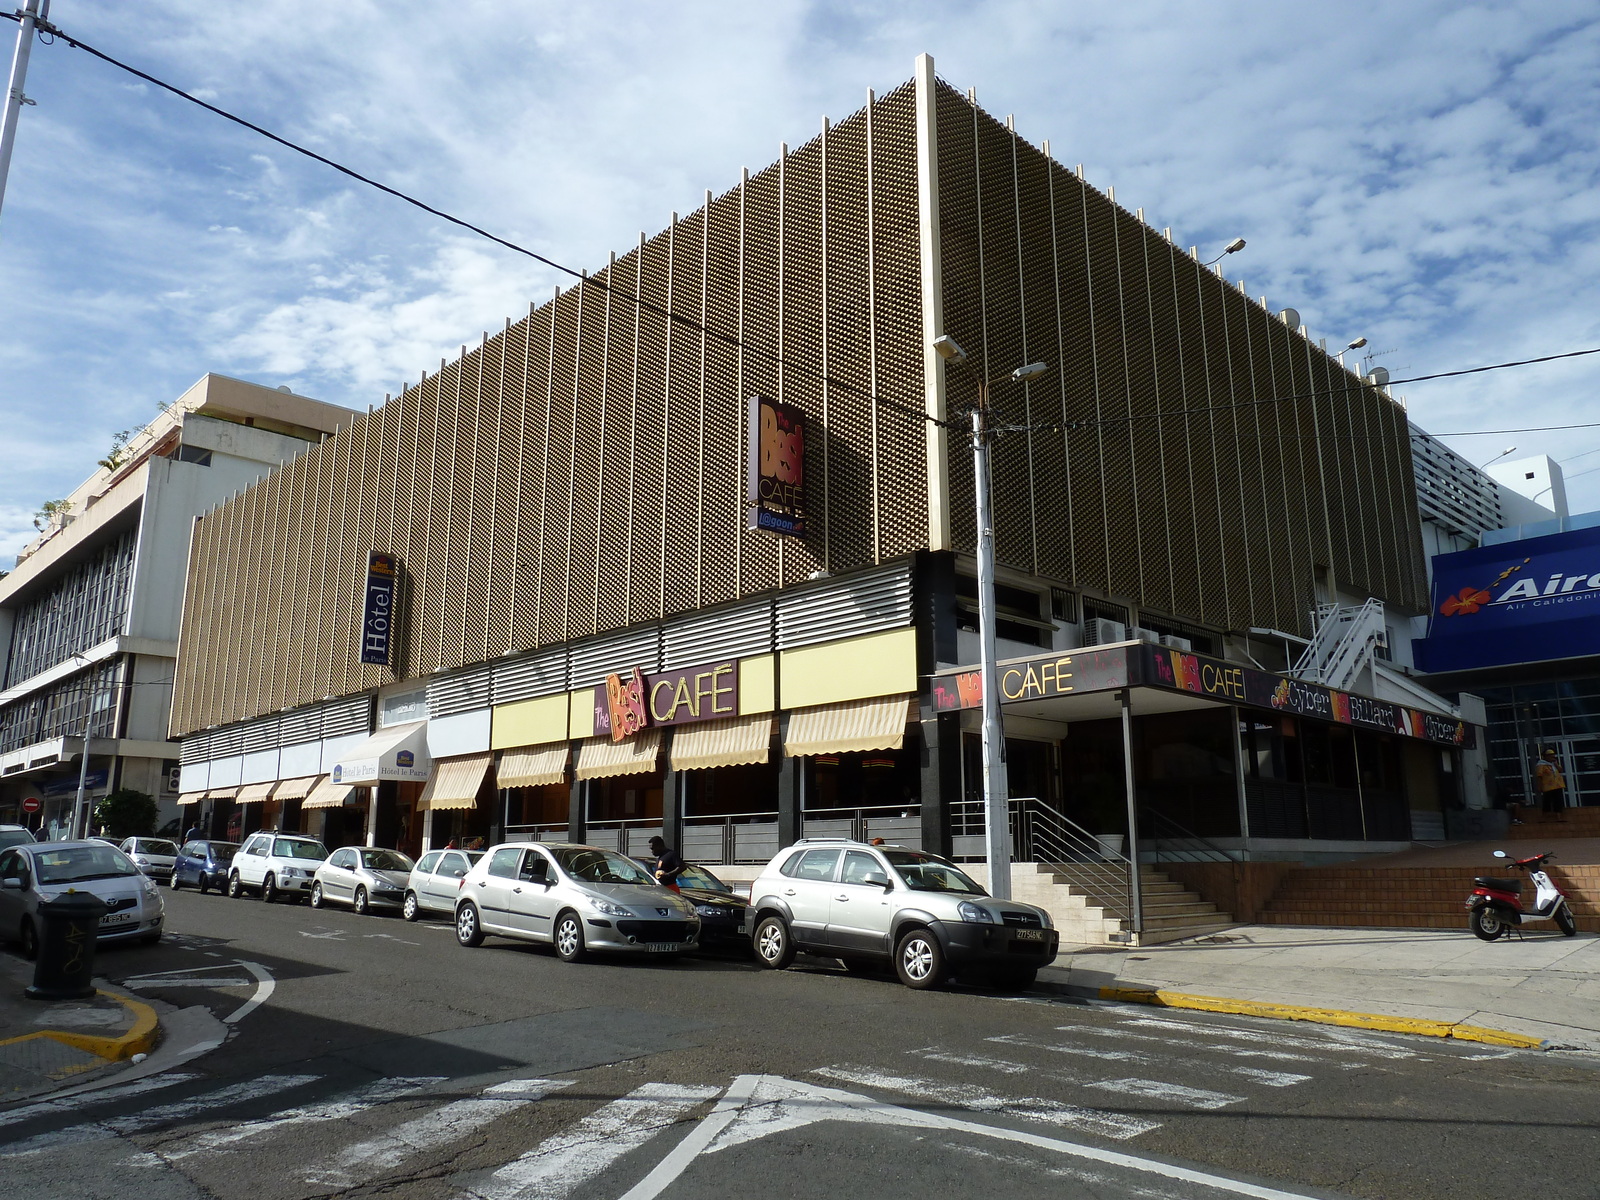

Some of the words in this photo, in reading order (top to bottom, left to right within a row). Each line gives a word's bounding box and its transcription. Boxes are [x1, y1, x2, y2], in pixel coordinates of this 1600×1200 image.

[776, 411, 790, 429] The
[758, 478, 803, 508] CAFÉ
[370, 565, 394, 575] Western
[375, 560, 389, 569] Best
[1506, 603, 1526, 611] Air
[1533, 593, 1600, 608] Calédoni
[366, 585, 390, 654] Hôtel
[370, 655, 387, 664] Paris
[934, 684, 956, 709] The
[1002, 657, 1074, 700] CAFÉ
[1154, 653, 1173, 682] The
[1202, 664, 1244, 699] CAFÉ
[594, 702, 610, 729] The
[650, 662, 733, 722] CAFÉ
[1288, 681, 1330, 714] Cyber
[1350, 696, 1395, 728] Billard
[1425, 714, 1455, 741] Cyber
[381, 767, 400, 776] Hôtel
[401, 768, 408, 776] le
[409, 768, 428, 777] Paris
